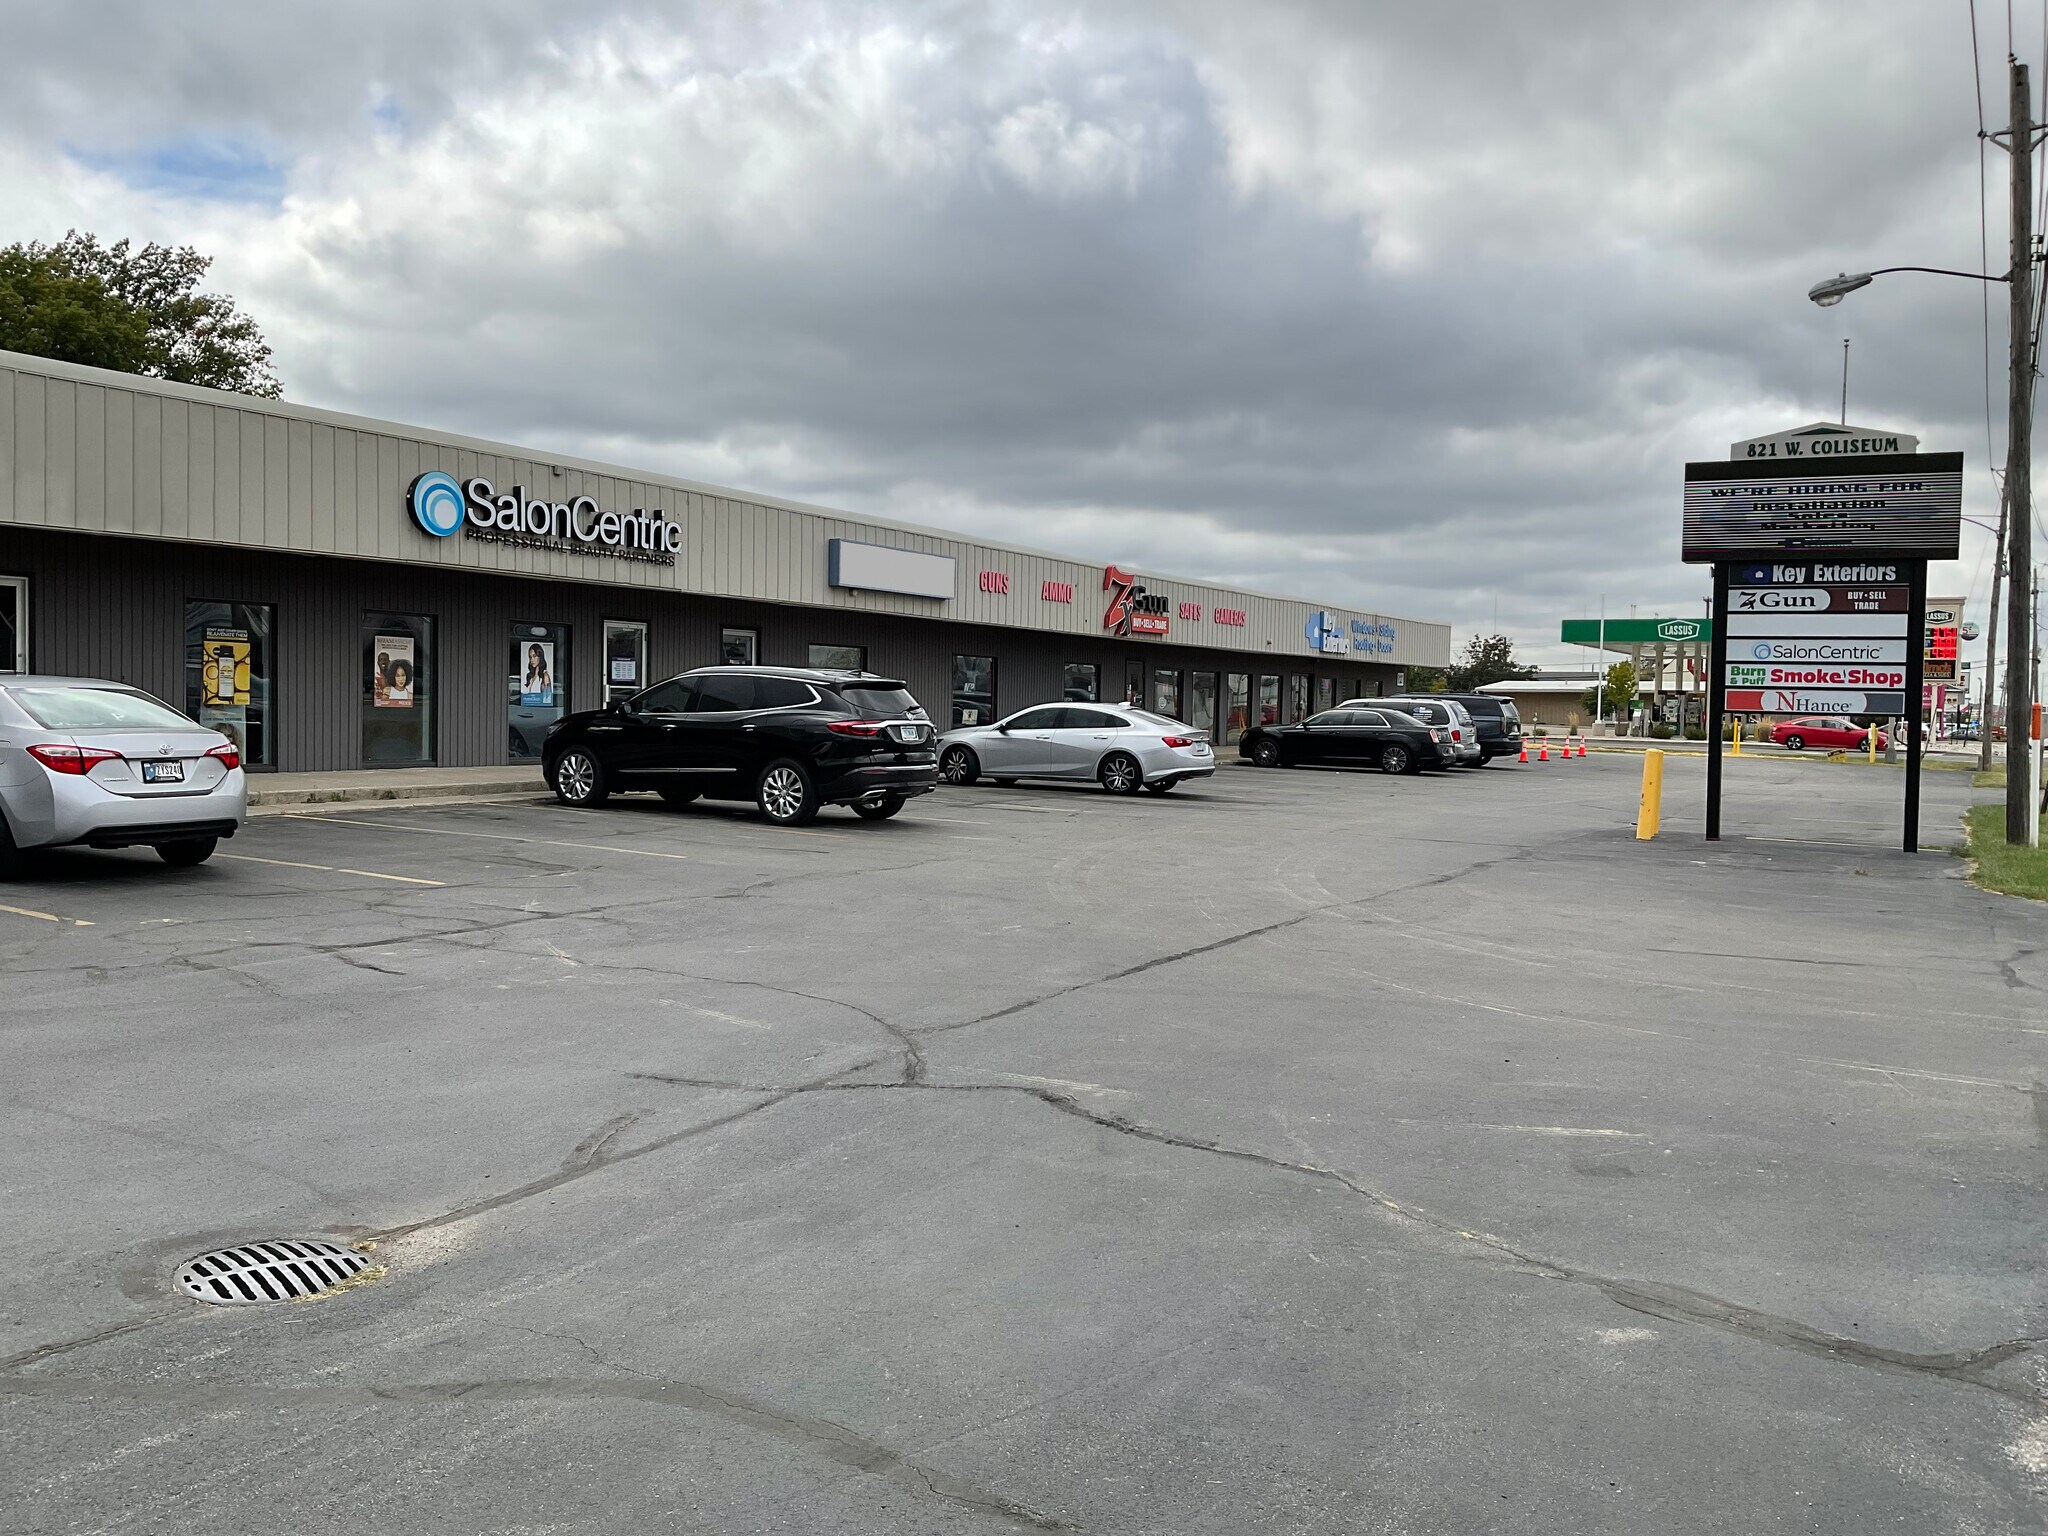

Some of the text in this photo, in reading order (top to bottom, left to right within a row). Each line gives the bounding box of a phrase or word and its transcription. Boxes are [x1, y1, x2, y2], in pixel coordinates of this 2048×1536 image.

[1747, 437, 1899, 457] 821 W. COLISEUM
[463, 477, 683, 554] SalonCentric
[466, 528, 675, 567] PROFESSIONAL BEAUTY PARTNERS
[1772, 563, 1897, 584] Key Exteriors
[979, 571, 1073, 604] GUNS AMMO
[1847, 591, 1886, 600] BUY SELL
[1132, 585, 1169, 613] Gun
[1854, 602, 1879, 610] TRADE
[1665, 625, 1693, 636] LASSUS
[1773, 644, 1880, 660] SalonCentric
[1730, 666, 1766, 676] Burn
[1770, 669, 1903, 687] Smoke Shop
[1730, 677, 1766, 685] & Puff
